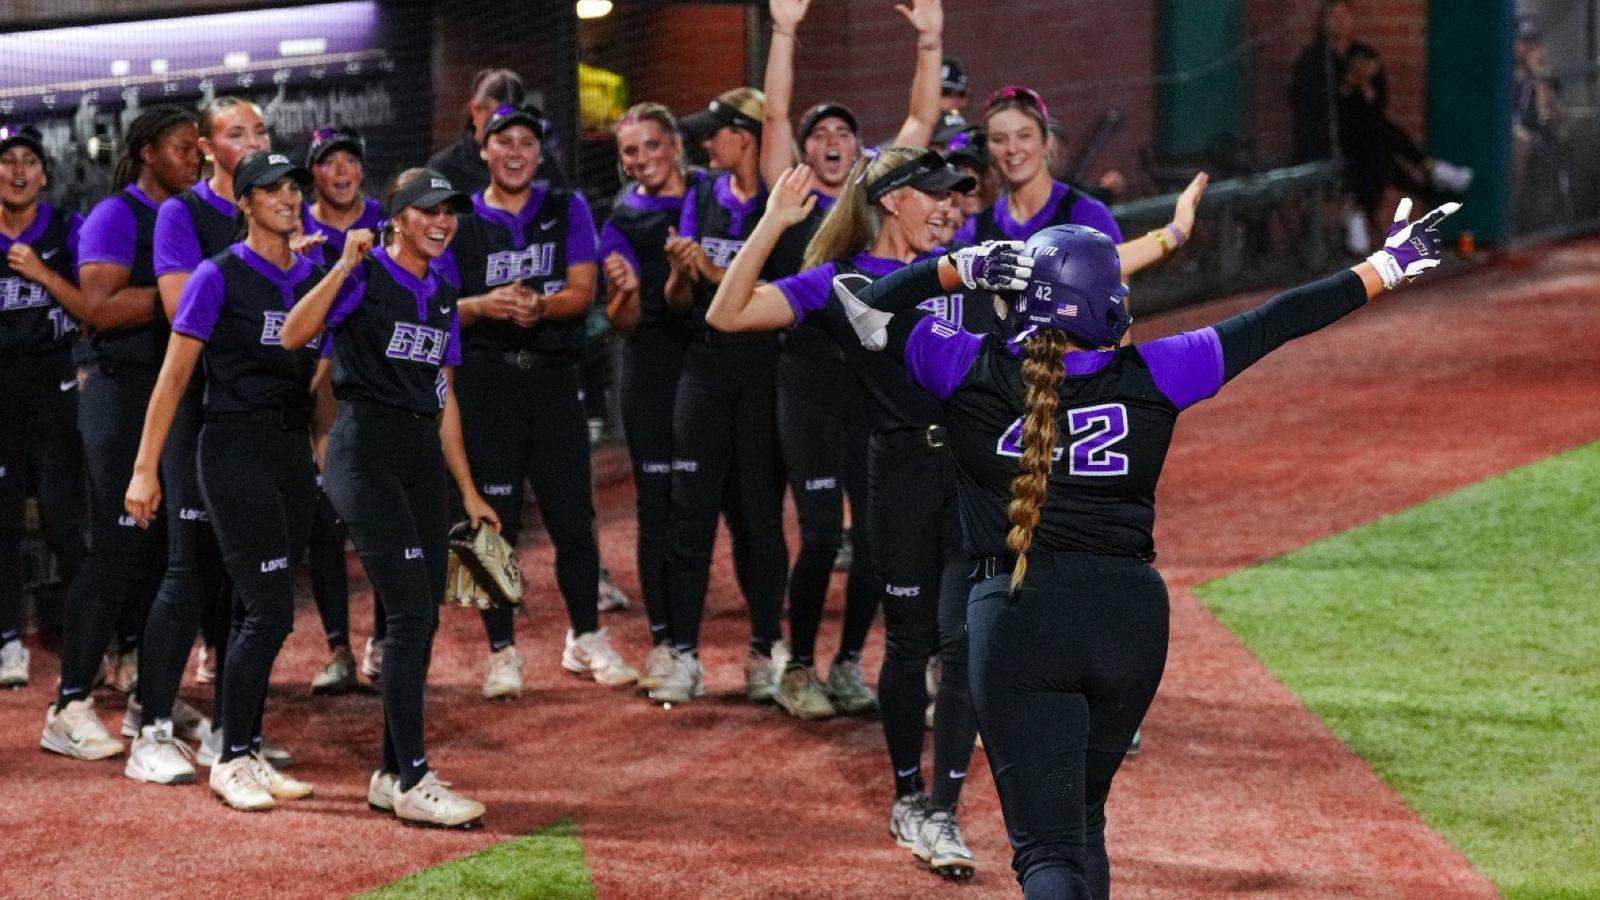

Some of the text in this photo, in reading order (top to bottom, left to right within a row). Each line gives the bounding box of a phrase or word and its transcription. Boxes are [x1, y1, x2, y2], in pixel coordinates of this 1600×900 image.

[486, 242, 556, 287] GCU
[1035, 285, 1052, 302] 42
[885, 584, 920, 597] LOPES
